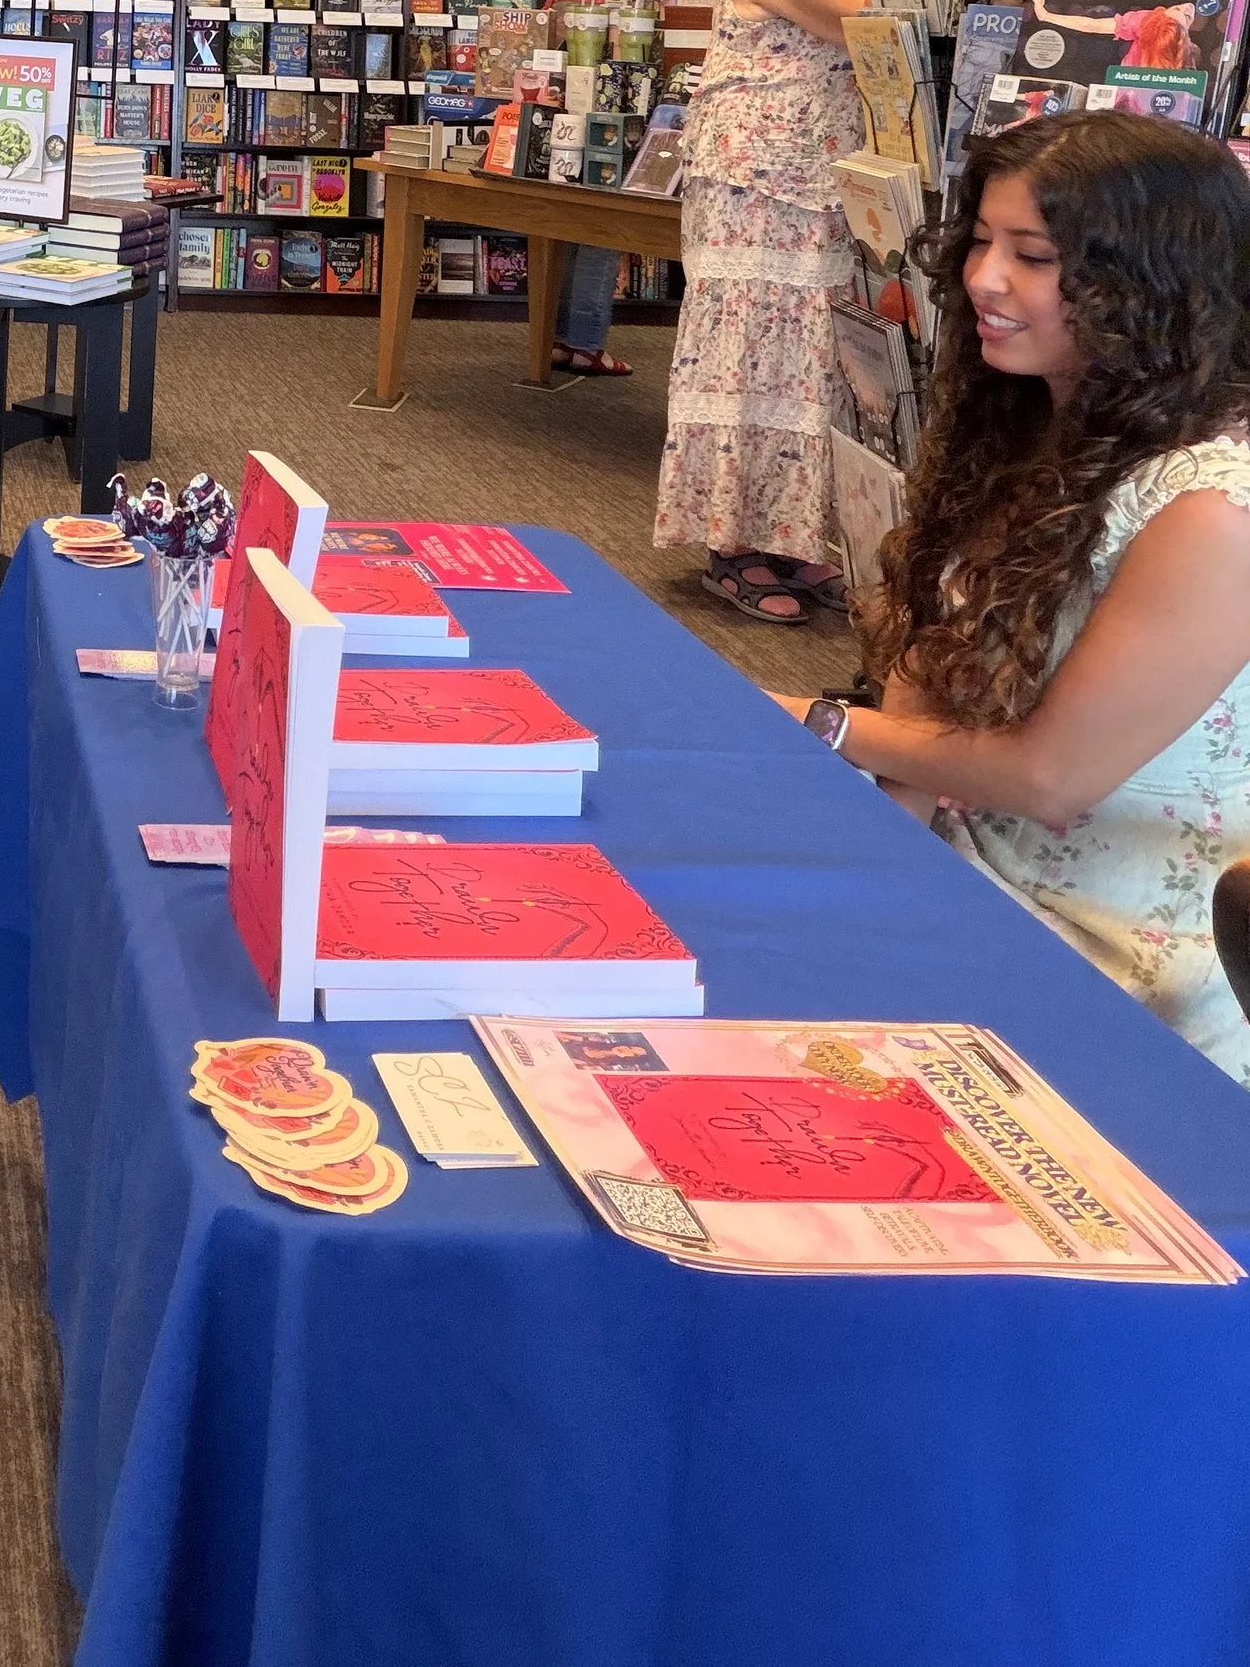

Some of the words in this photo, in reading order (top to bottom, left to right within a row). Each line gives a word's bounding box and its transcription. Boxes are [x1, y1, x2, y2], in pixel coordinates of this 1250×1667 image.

[51, 14, 84, 26] Switzy
[502, 11, 532, 22] SHIP
[317, 29, 348, 37] CHILDREN
[317, 49, 334, 57] THE
[19, 65, 52, 83] 50%
[1114, 71, 1141, 81] Artist
[1141, 72, 1152, 82] of
[1152, 73, 1167, 83] the
[1168, 74, 1197, 85] Month
[428, 96, 466, 108] GEOMAG
[196, 103, 217, 114] DICE
[312, 159, 328, 167] LAST
[316, 168, 346, 176] BROOKLYN
[27, 189, 49, 198] recipes
[9, 195, 31, 205] craving
[178, 241, 211, 255] family
[330, 240, 345, 249] Matt
[345, 242, 360, 252] Haig
[331, 260, 358, 268] MIDNIGHT
[822, 1040, 853, 1071] ORDER
[912, 1061, 1023, 1162] MUST-READ
[1013, 1161, 1089, 1227] NOVEL
[936, 1058, 1034, 1145] DISCOVER
[1026, 1145, 1079, 1189] THE
[1070, 1183, 1128, 1233] NEW
